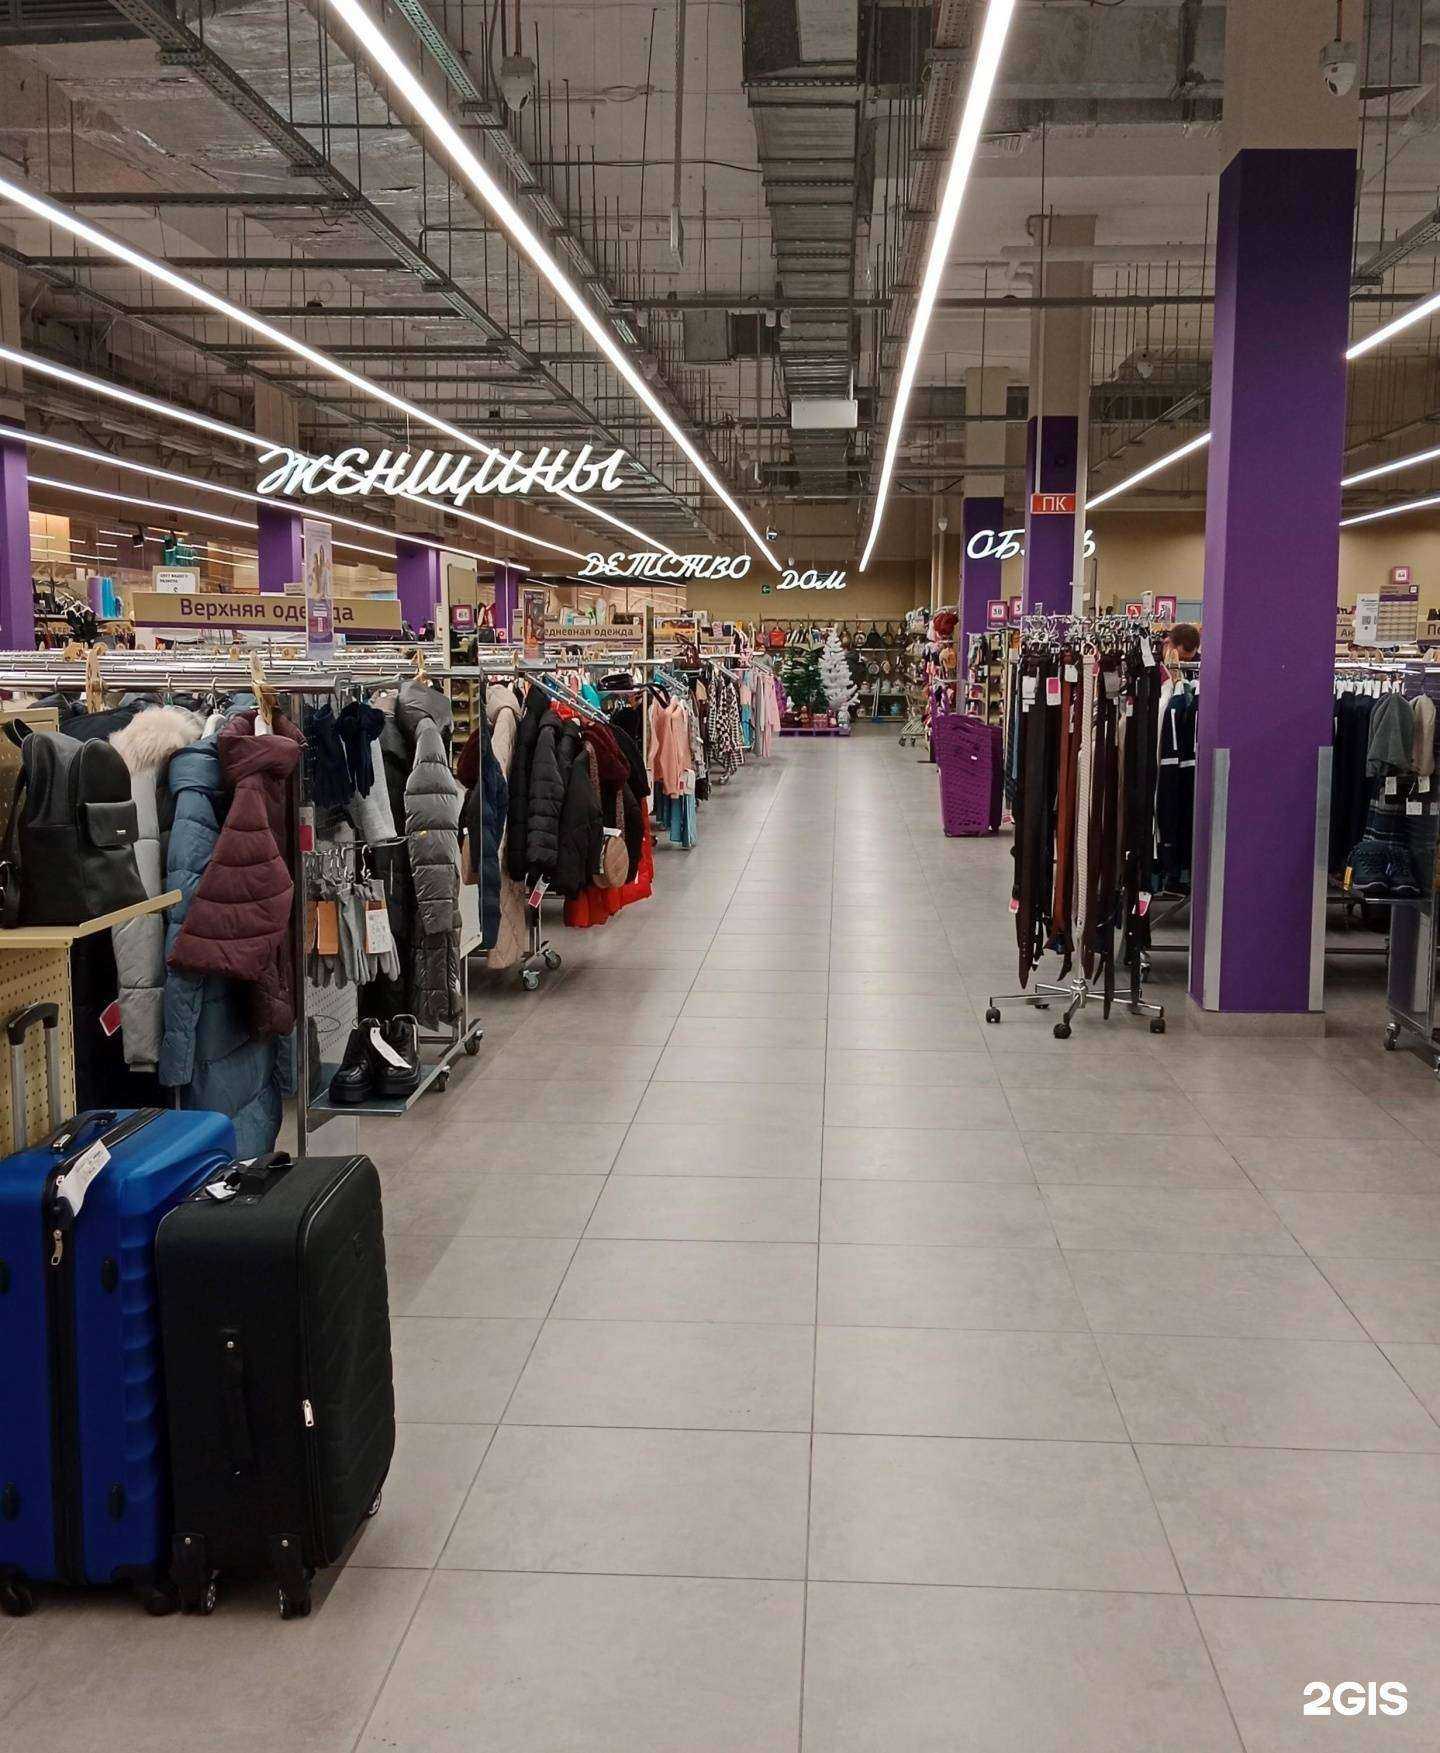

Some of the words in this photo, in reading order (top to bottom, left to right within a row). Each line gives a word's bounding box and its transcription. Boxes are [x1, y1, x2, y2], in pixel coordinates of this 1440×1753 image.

[256, 444, 625, 507] ЖЕНЩИНЫ
[1042, 496, 1067, 511] ПК
[966, 529, 1096, 560] ОБЬ
[577, 551, 752, 580] ДЕТСТВО
[776, 568, 847, 590] ДОМ
[180, 598, 266, 621] Верхняя
[272, 604, 355, 624] одеда
[594, 629, 634, 638] одежда
